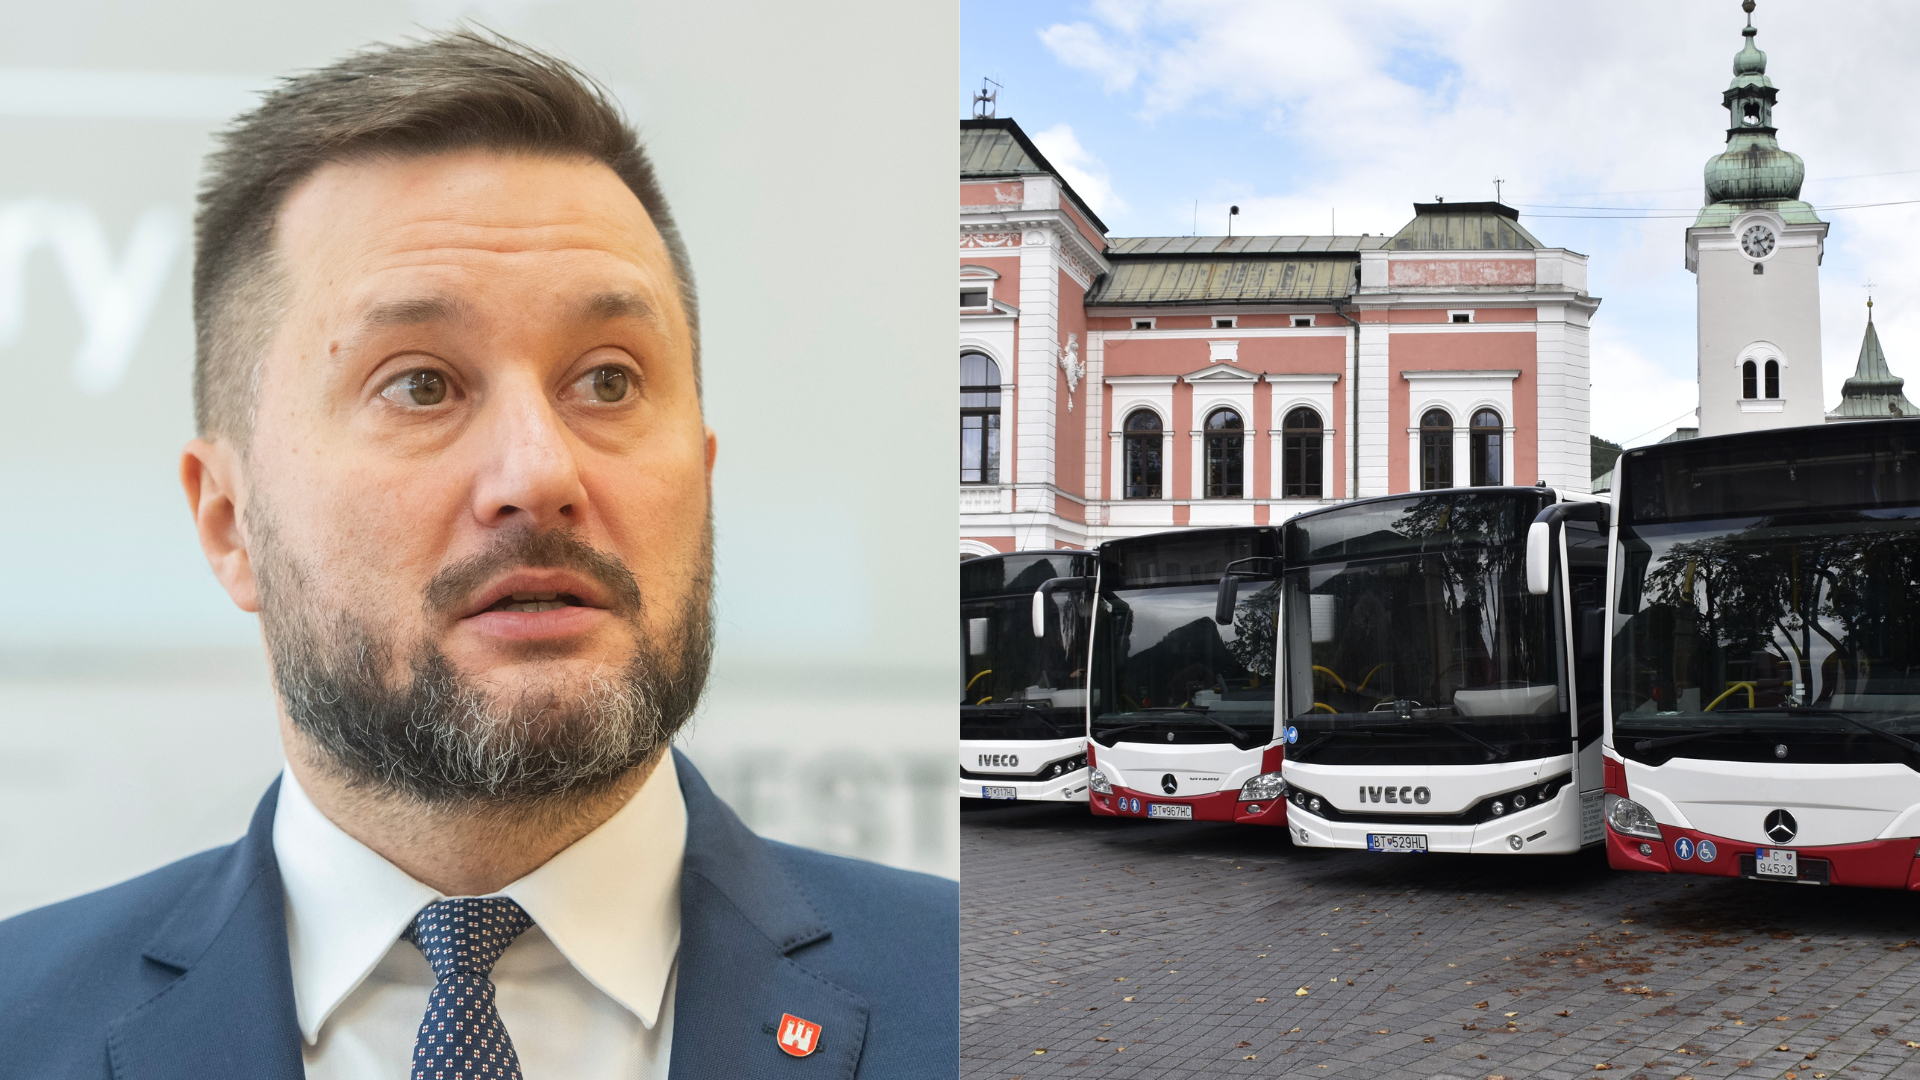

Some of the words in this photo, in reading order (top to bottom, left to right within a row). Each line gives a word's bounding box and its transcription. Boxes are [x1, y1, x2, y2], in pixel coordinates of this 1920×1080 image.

[978, 754, 1019, 767] IVECO
[1359, 786, 1431, 804] IVECO
[1773, 851, 1779, 861] C
[1760, 863, 1794, 875] 94532
